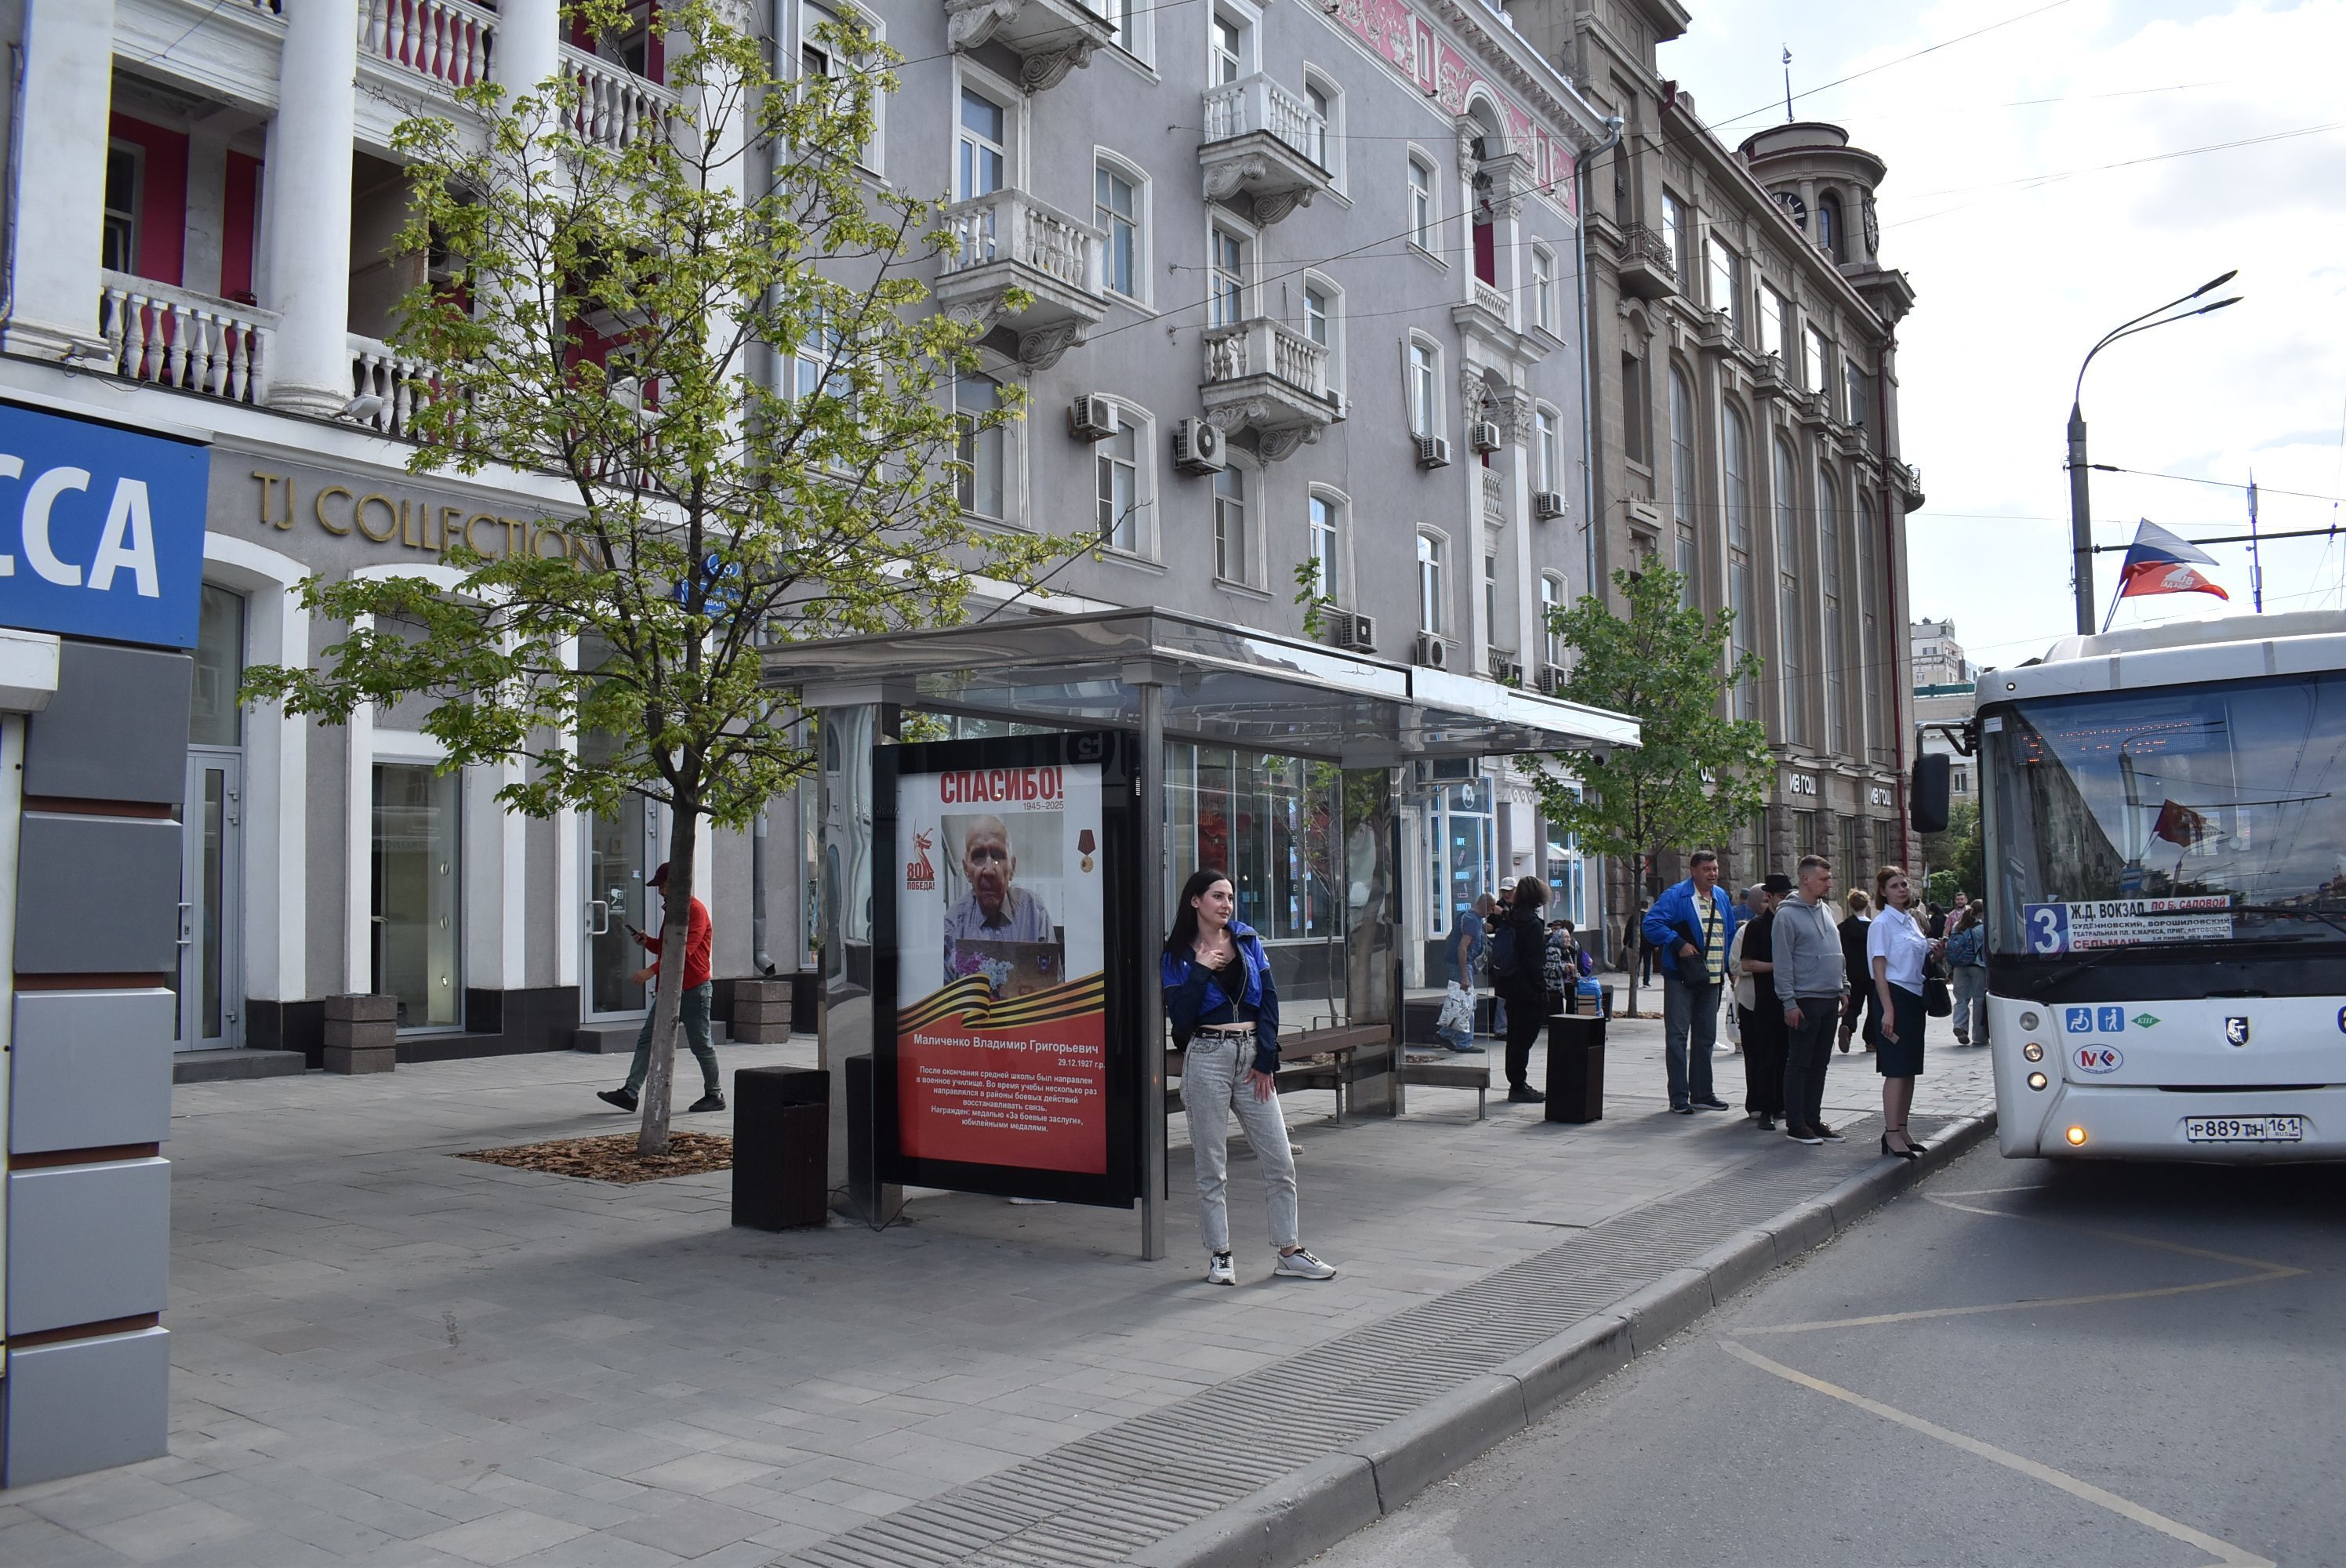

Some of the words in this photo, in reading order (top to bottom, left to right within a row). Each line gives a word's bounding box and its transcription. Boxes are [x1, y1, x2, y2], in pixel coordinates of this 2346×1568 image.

[252, 470, 295, 530] TJ
[316, 485, 605, 571] COLLECTION
[941, 767, 1063, 804] СПАСИБО!
[1801, 775, 1816, 794] ГОШ
[906, 862, 922, 879] 80
[906, 881, 935, 891] ПОБЕДА!
[2152, 901, 2164, 910] ПО
[2179, 896, 2226, 909] САДОВОЙ
[2071, 904, 2096, 922] Ж.Д.
[2099, 902, 2144, 919] ВОКЗАЛ
[2034, 909, 2060, 953] 3
[913, 1034, 970, 1047] Маличенко
[973, 1036, 1026, 1051] Владимир
[1030, 1040, 1099, 1054] Григорьевич
[1058, 1058, 1093, 1068] 29.12.1927
[952, 1079, 985, 1087] училище.
[1045, 1086, 1082, 1094] несколько
[1037, 1073, 1052, 1082] был
[1054, 1076, 1093, 1084] направлен
[933, 1087, 978, 1097] направлялся
[986, 1091, 1013, 1099] районы
[1015, 1092, 1042, 1102] боевых
[1044, 1094, 1078, 1104] действий
[963, 1099, 1022, 1109] восстанавливать
[931, 1105, 971, 1116] Награжден:
[1006, 1111, 1018, 1120] «За
[1019, 1112, 1048, 1122] боевые
[1049, 1116, 1084, 1126] заслуги»,
[962, 1118, 1008, 1129] юбилейными
[1010, 1123, 1048, 1131] медалями.
[2268, 1119, 2295, 1131] 161
